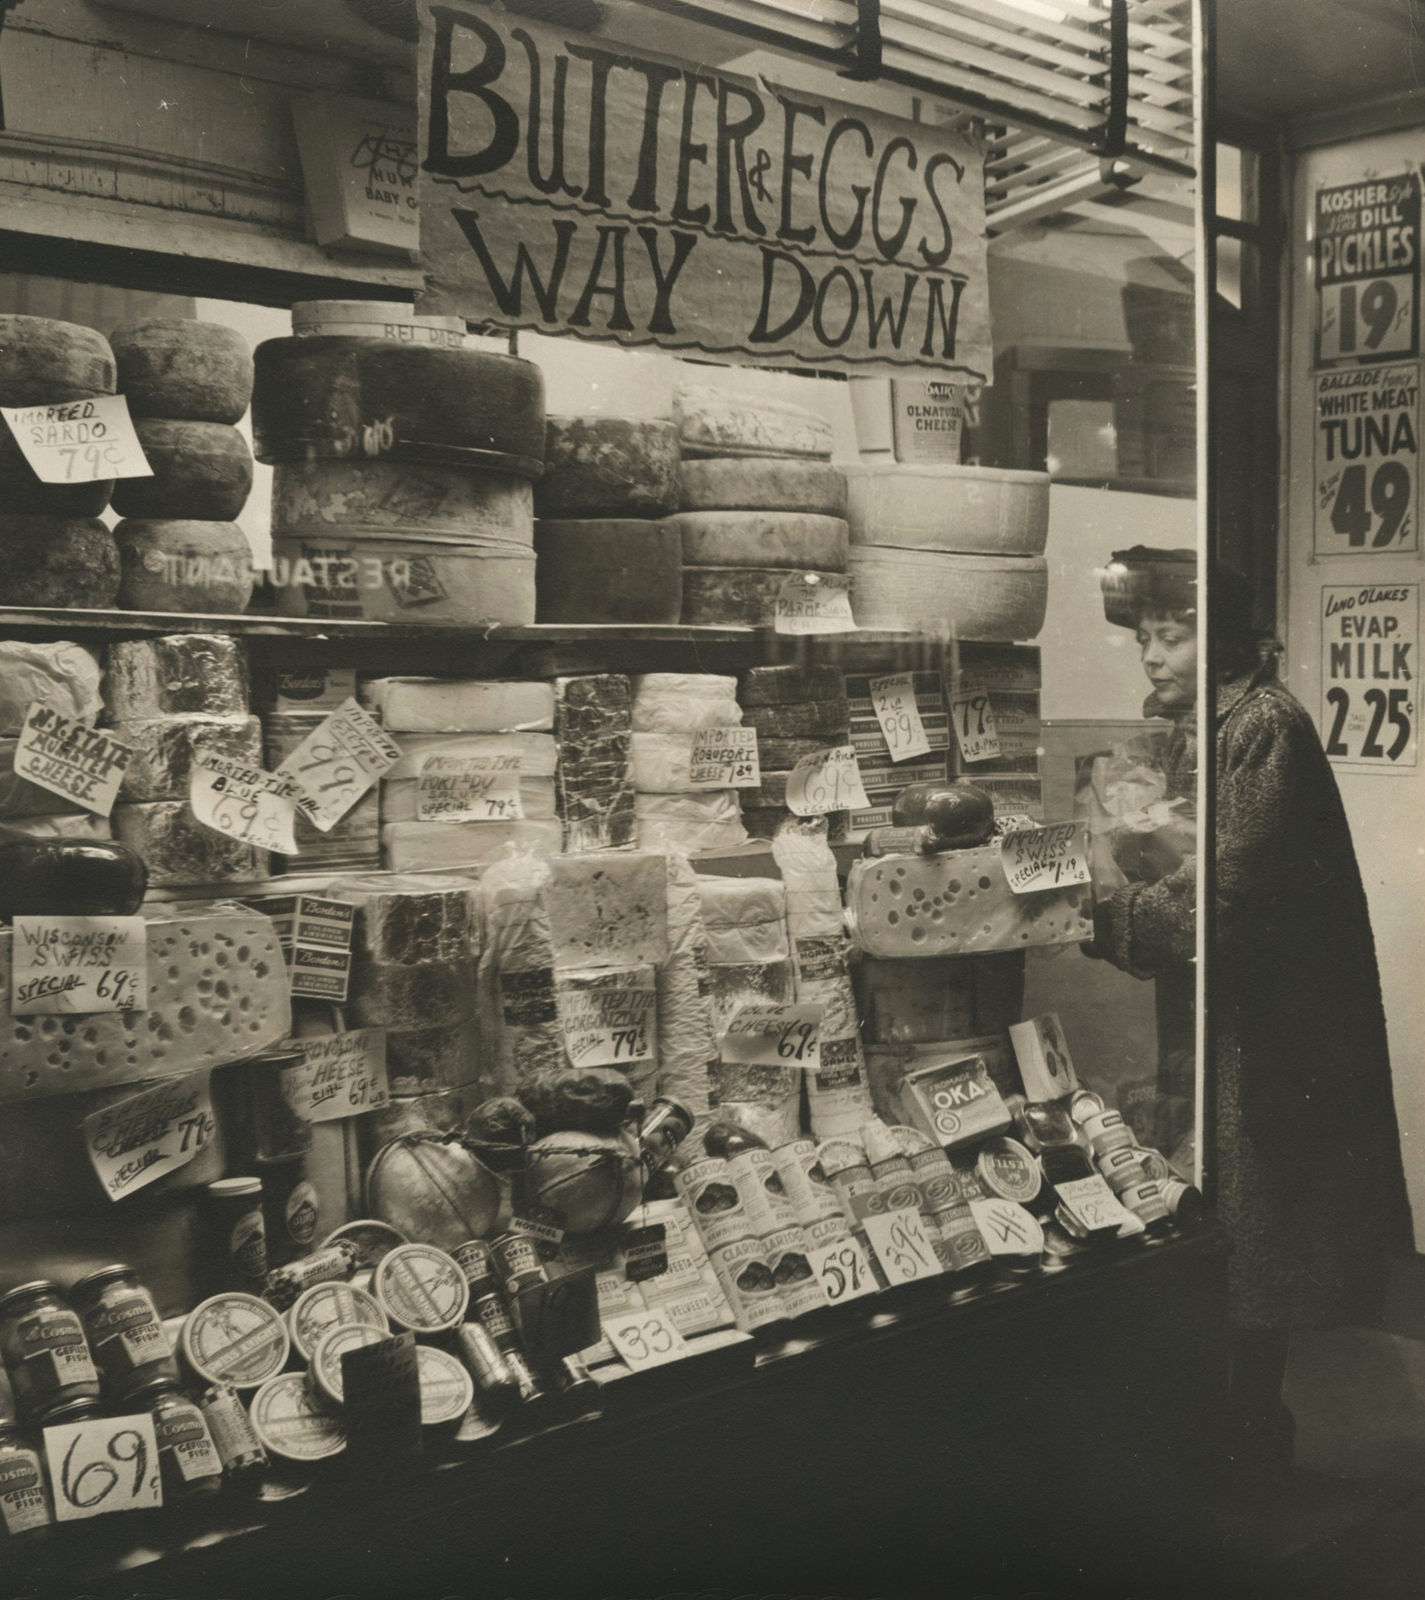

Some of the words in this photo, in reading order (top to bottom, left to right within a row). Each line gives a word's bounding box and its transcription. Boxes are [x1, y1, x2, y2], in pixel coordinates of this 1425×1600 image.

[421, 6, 766, 236] BUTTER
[749, 148, 772, 204] &
[763, 75, 965, 266] EGGS
[1321, 184, 1389, 214] KOSHER
[1361, 205, 1404, 226] DILL
[1320, 226, 1415, 278] PICKLES
[451, 208, 698, 335] WAY
[749, 246, 967, 360] DOWN
[1319, 370, 1381, 392] BALLADE
[1319, 391, 1369, 416] WHITE
[1372, 387, 1418, 413] MEAT
[30, 421, 108, 445] SARDO
[915, 418, 957, 432] CHEESE
[1320, 412, 1418, 462] TUNA
[1325, 593, 1355, 618] LAND
[1330, 642, 1413, 682] MILK
[871, 676, 914, 693] SPECIAL
[694, 728, 756, 746] IMPORTED
[29, 756, 99, 803] CHEESE
[210, 776, 262, 805] BLUE
[1002, 823, 1077, 850] IMPORTED
[1015, 840, 1067, 865] SWISS
[1010, 860, 1048, 888] SPECIAL
[20, 923, 129, 946] WISCONSIN
[30, 943, 116, 967] SWISS
[17, 974, 87, 1002] SPECIAL
[310, 1056, 366, 1088] HEESE
[822, 1055, 857, 1067] ORMEL
[311, 1082, 344, 1102] CIAL
[934, 1080, 986, 1109] OKA
[598, 1278, 619, 1294] EETA
[670, 1294, 711, 1318] VELVEETA
[0, 1465, 35, 1482] osmo
